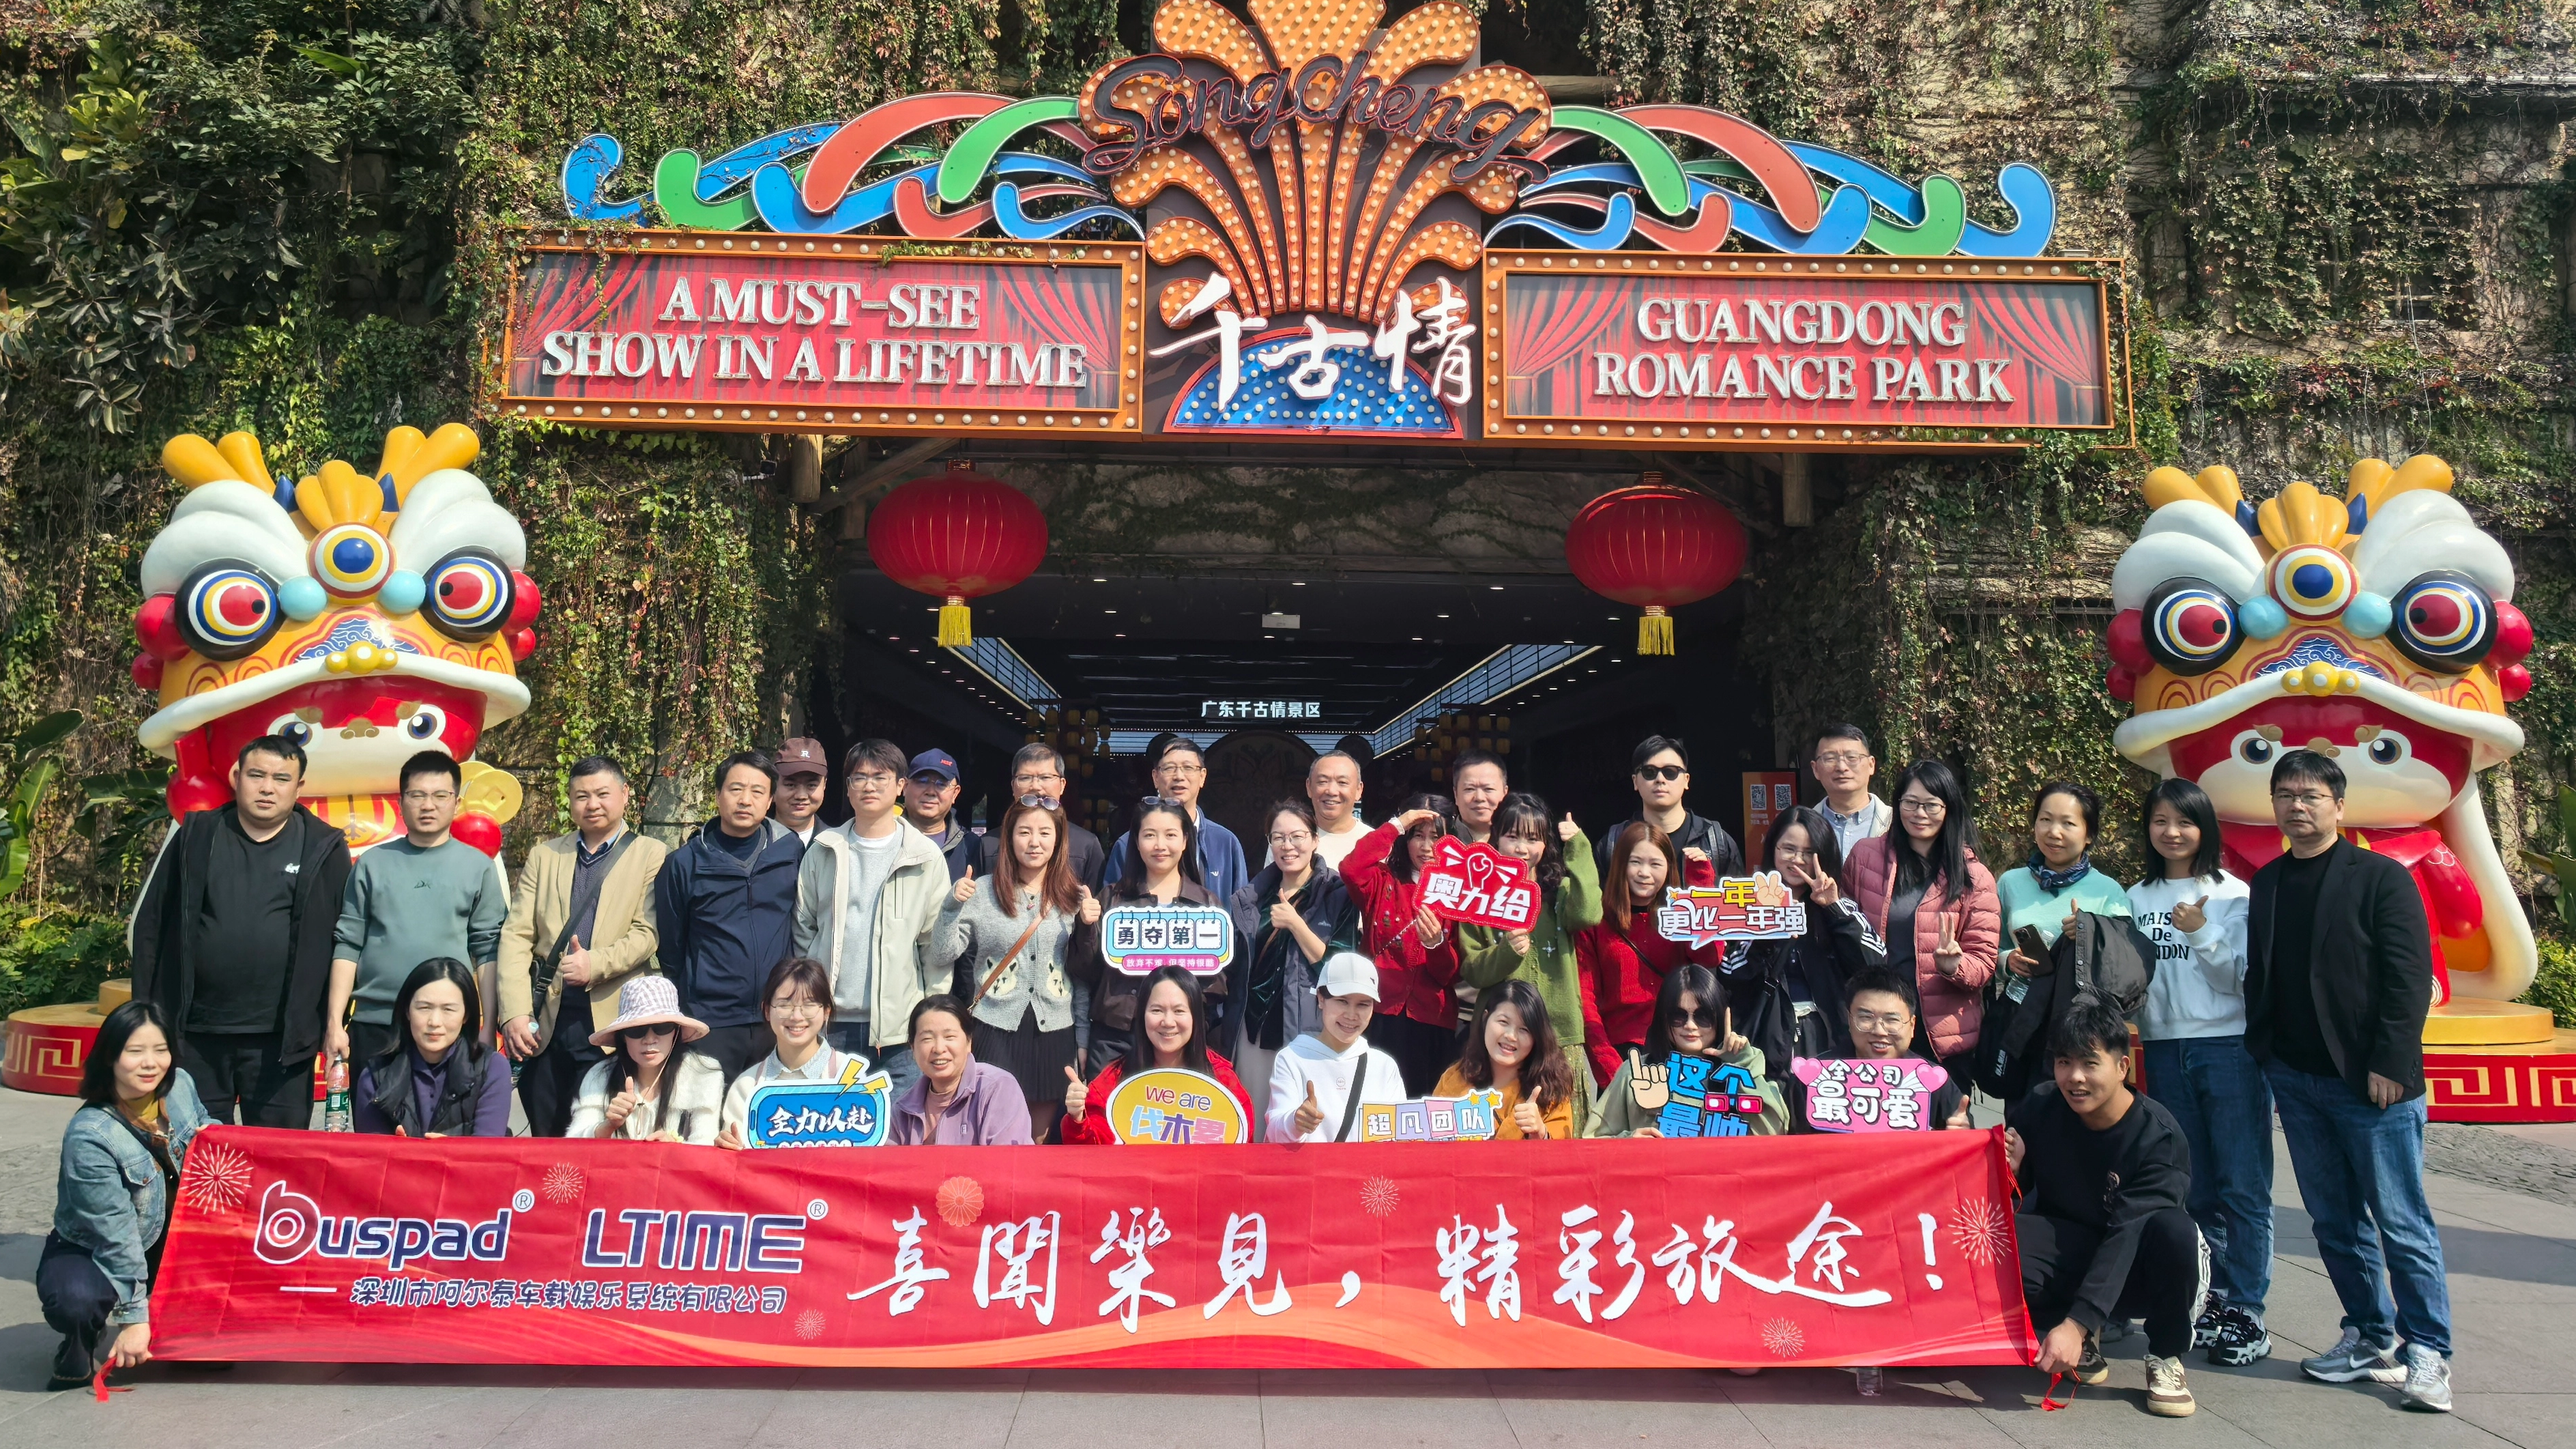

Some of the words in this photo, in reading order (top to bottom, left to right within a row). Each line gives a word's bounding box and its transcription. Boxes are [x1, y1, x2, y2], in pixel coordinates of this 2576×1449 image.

[659, 276, 697, 321] A
[708, 278, 980, 330] MUST-SEE
[1148, 270, 1477, 412] 千古情
[1638, 298, 1966, 347] GUANGDONG
[542, 330, 707, 379] SHOW
[712, 334, 779, 380] IN
[784, 337, 824, 382] A
[834, 340, 1088, 388] LIFETIME
[1593, 352, 1857, 401] ROMANCE
[1871, 357, 2015, 403] PARK
[1201, 700, 1320, 718] 广东千古情景区
[1421, 872, 1531, 923] 奥力给
[1690, 880, 1756, 908] 一年
[1117, 926, 1219, 945] 勇夺第一
[2152, 928, 2172, 941] De
[1827, 1059, 1902, 1087] 全公司
[1145, 1085, 1175, 1104] we
[1178, 1093, 1212, 1112] are
[1811, 1080, 1921, 1129] 最可爱
[767, 1103, 875, 1138] 全力以赴
[1367, 1107, 1486, 1137] 超凡团队
[582, 1207, 806, 1274] LTIME
[349, 1277, 787, 1314] 深圳市阿尔泰车载娱乐系统有限公司
